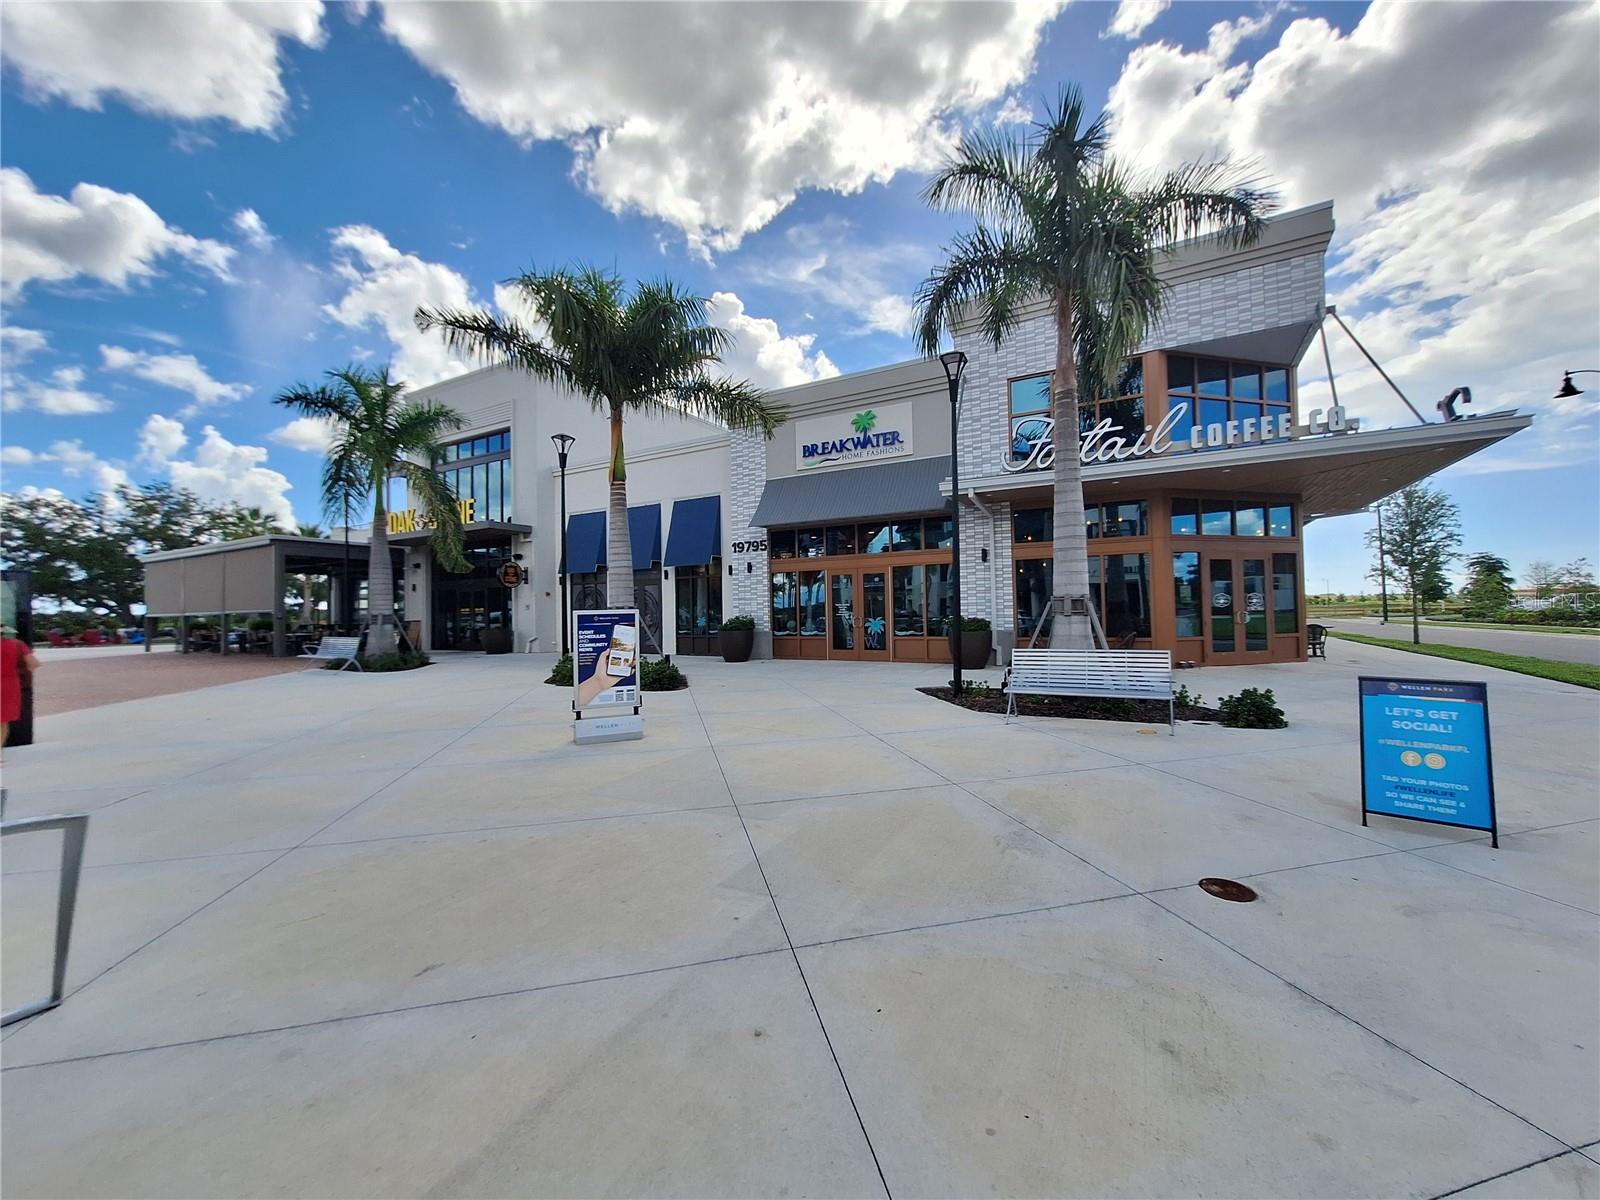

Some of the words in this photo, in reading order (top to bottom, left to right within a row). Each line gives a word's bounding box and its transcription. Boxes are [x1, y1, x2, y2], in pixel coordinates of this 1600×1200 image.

[802, 430, 904, 458] BREAKWATER
[1001, 402, 1188, 472] Fotail
[1191, 413, 1291, 449] COFFEE
[1309, 406, 1359, 435] CO.
[842, 452, 864, 461] HOME
[867, 446, 905, 457] FASHIONS
[387, 507, 415, 535] OAK
[731, 540, 767, 553] 19795
[1384, 707, 1424, 718] LET'S
[1428, 710, 1459, 721] GET
[1391, 720, 1453, 734] SOCIAL!
[1400, 777, 1427, 786] YOUR
[1429, 781, 1470, 791] PHOTOS
[1394, 800, 1425, 811] SHARE
[1438, 799, 1457, 807] SEE
